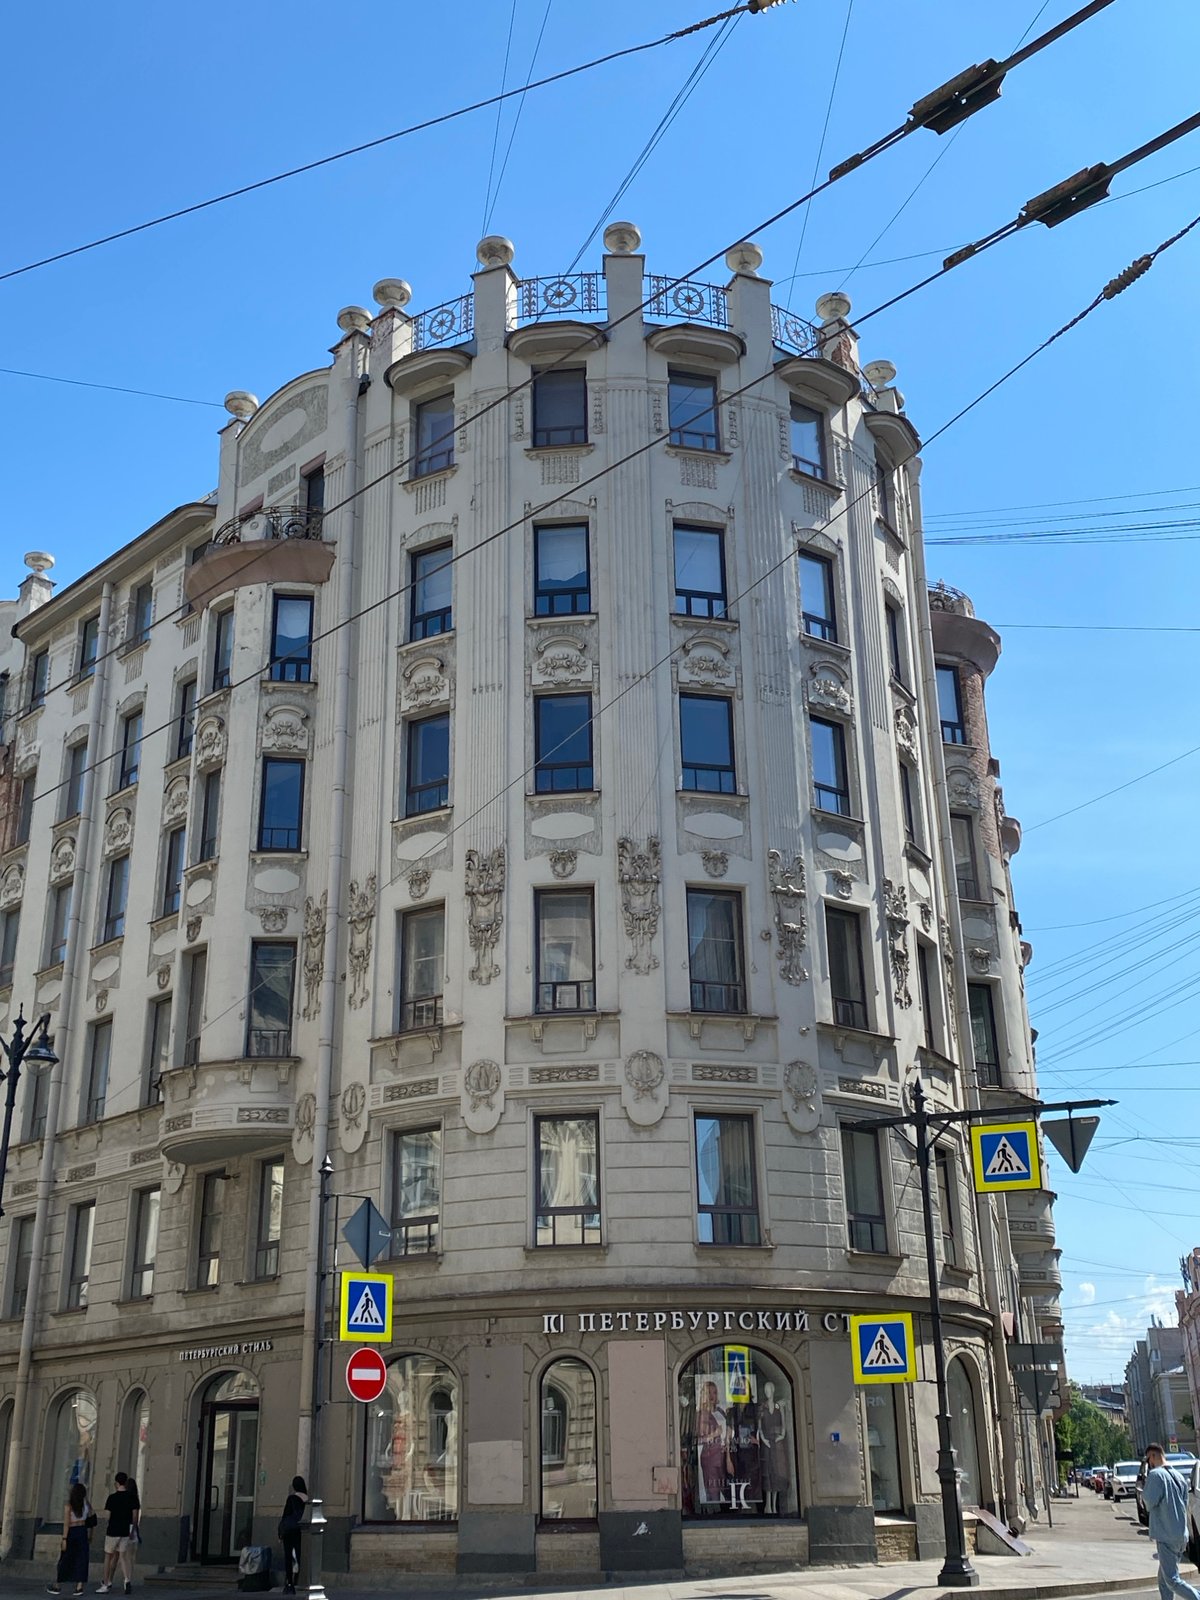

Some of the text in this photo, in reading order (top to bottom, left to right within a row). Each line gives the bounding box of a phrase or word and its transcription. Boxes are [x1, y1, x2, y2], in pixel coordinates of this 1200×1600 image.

[578, 1309, 811, 1332] ПЕТЕРБУРГСКИЙ
[179, 1340, 272, 1361] ПЕТЕРБУРГСКИЙ СТИЛЬ
